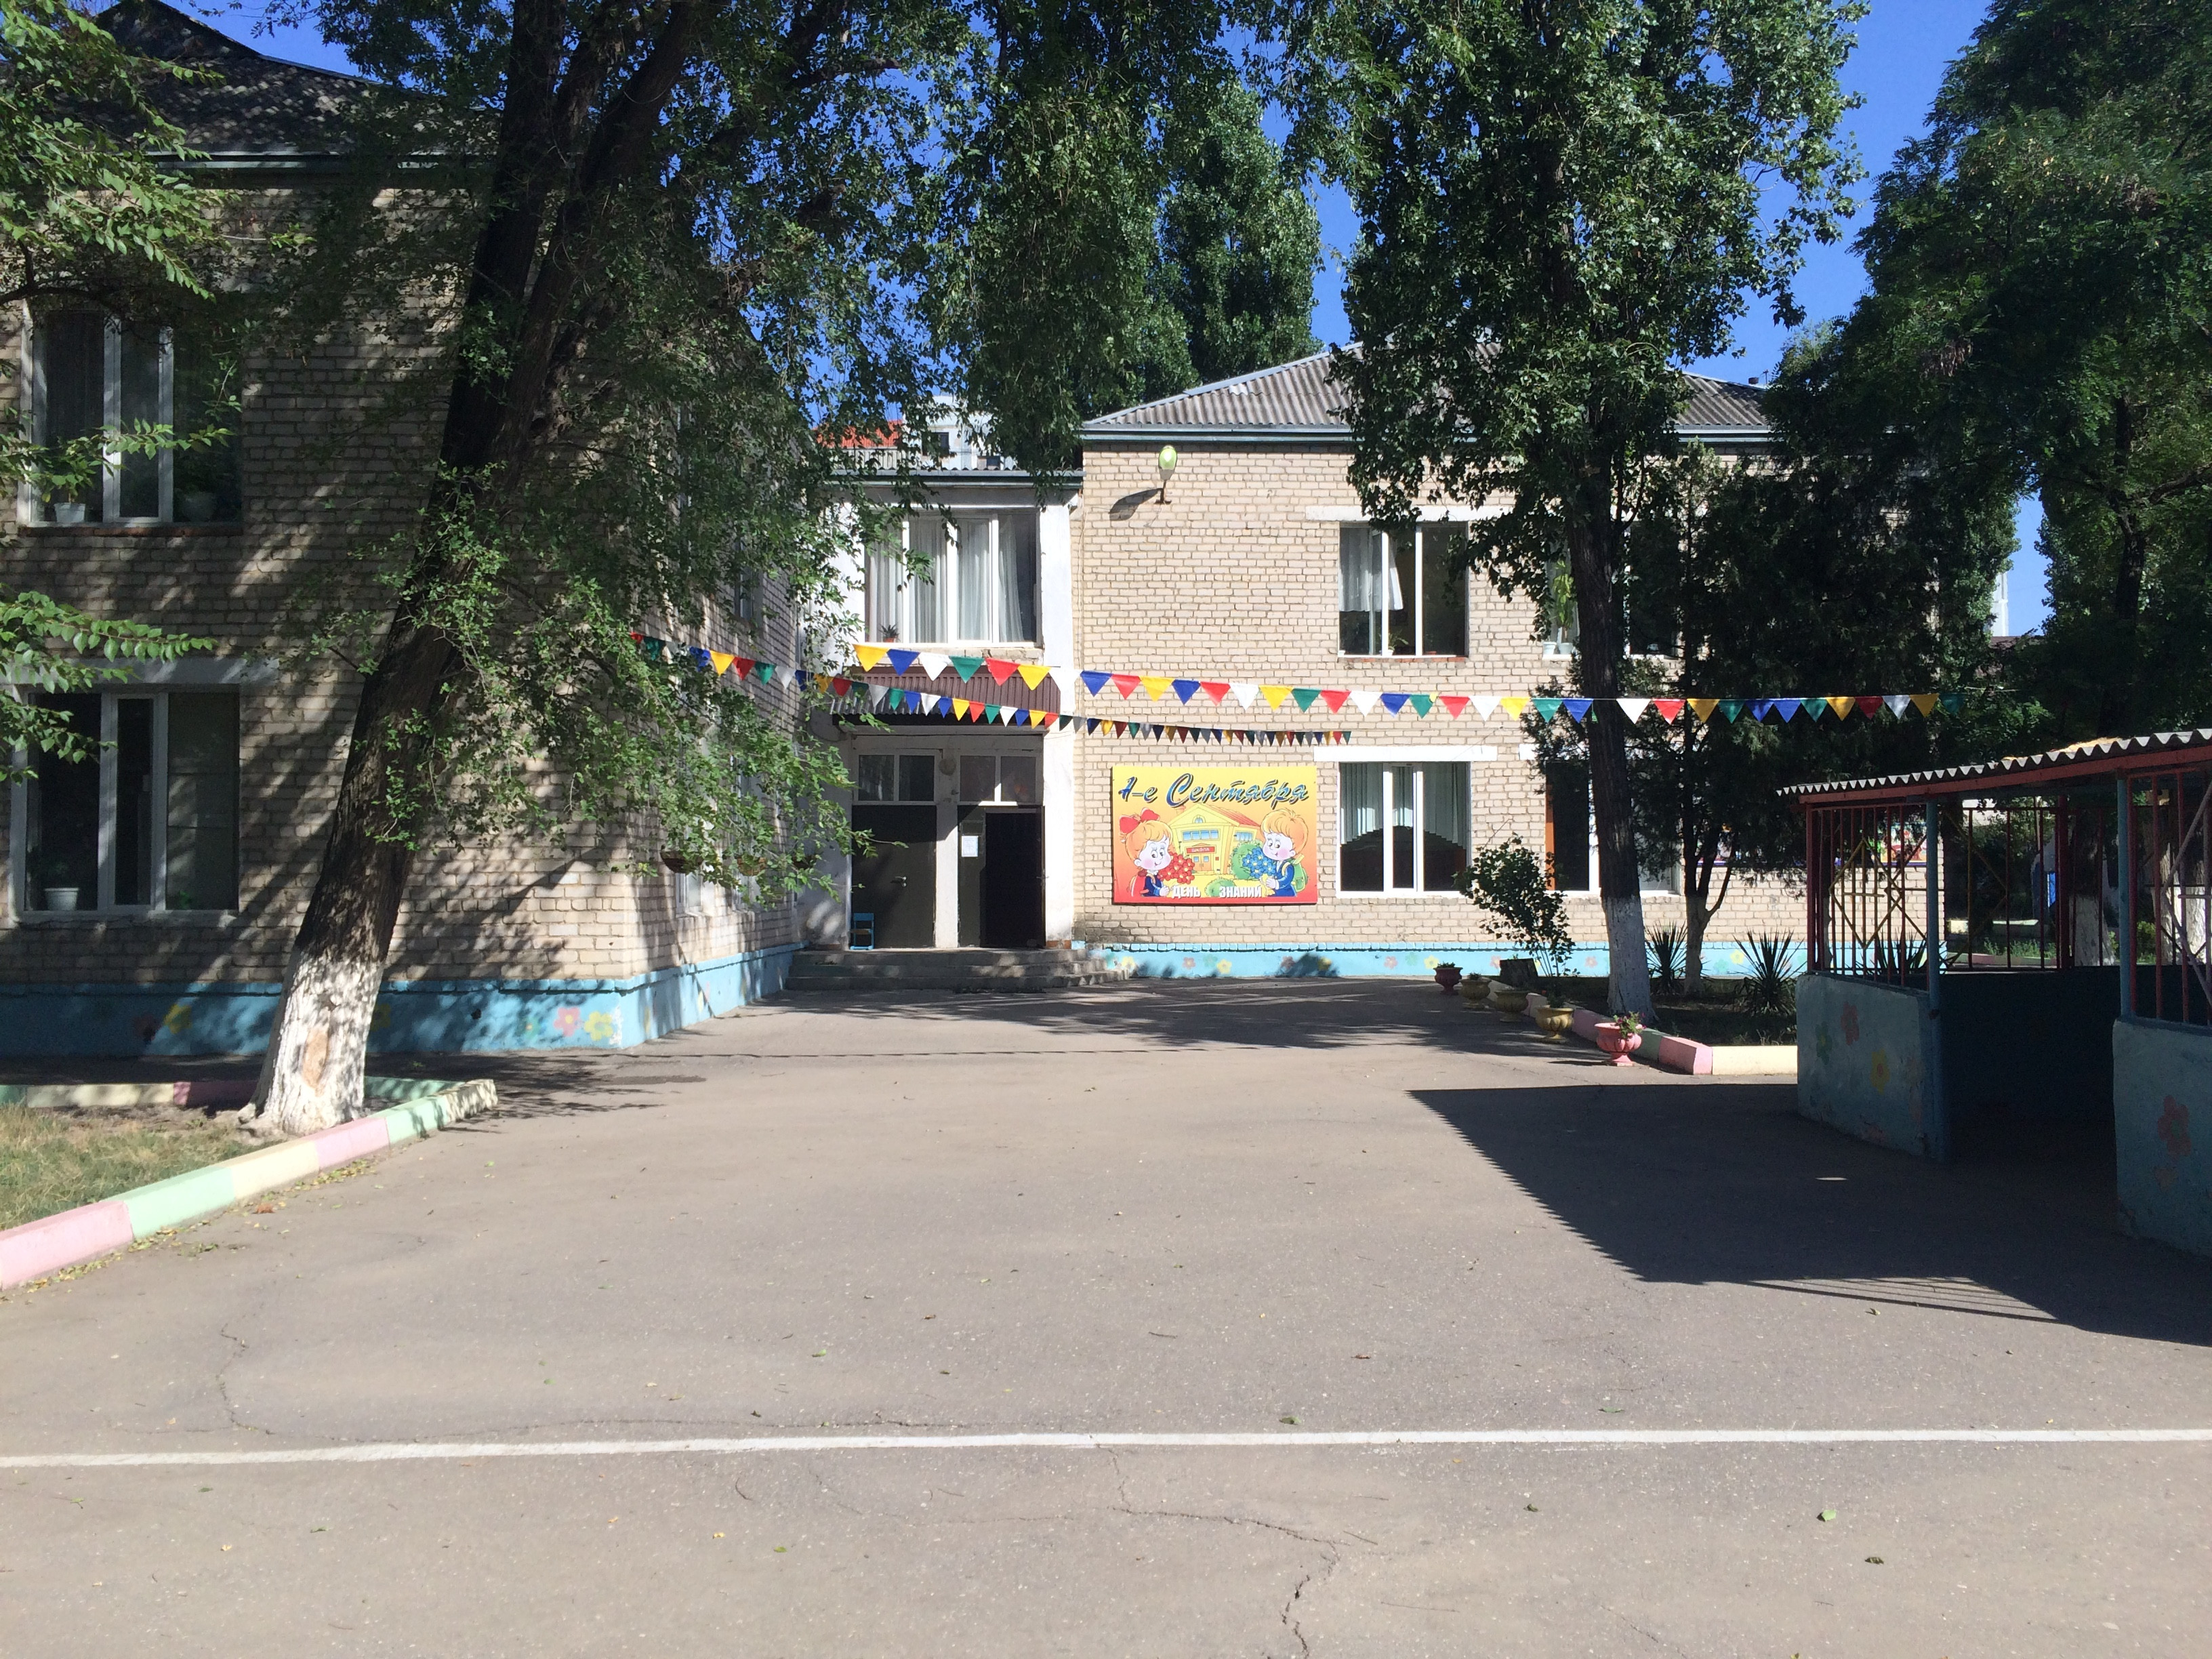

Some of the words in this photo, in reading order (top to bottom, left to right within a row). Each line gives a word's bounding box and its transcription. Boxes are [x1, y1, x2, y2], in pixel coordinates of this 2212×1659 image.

[1118, 776, 1158, 803] 1-е
[1166, 773, 1309, 810] Сентября
[1172, 885, 1202, 899] ДЕНЬ
[1219, 886, 1263, 898] ЗНАНИЙ
